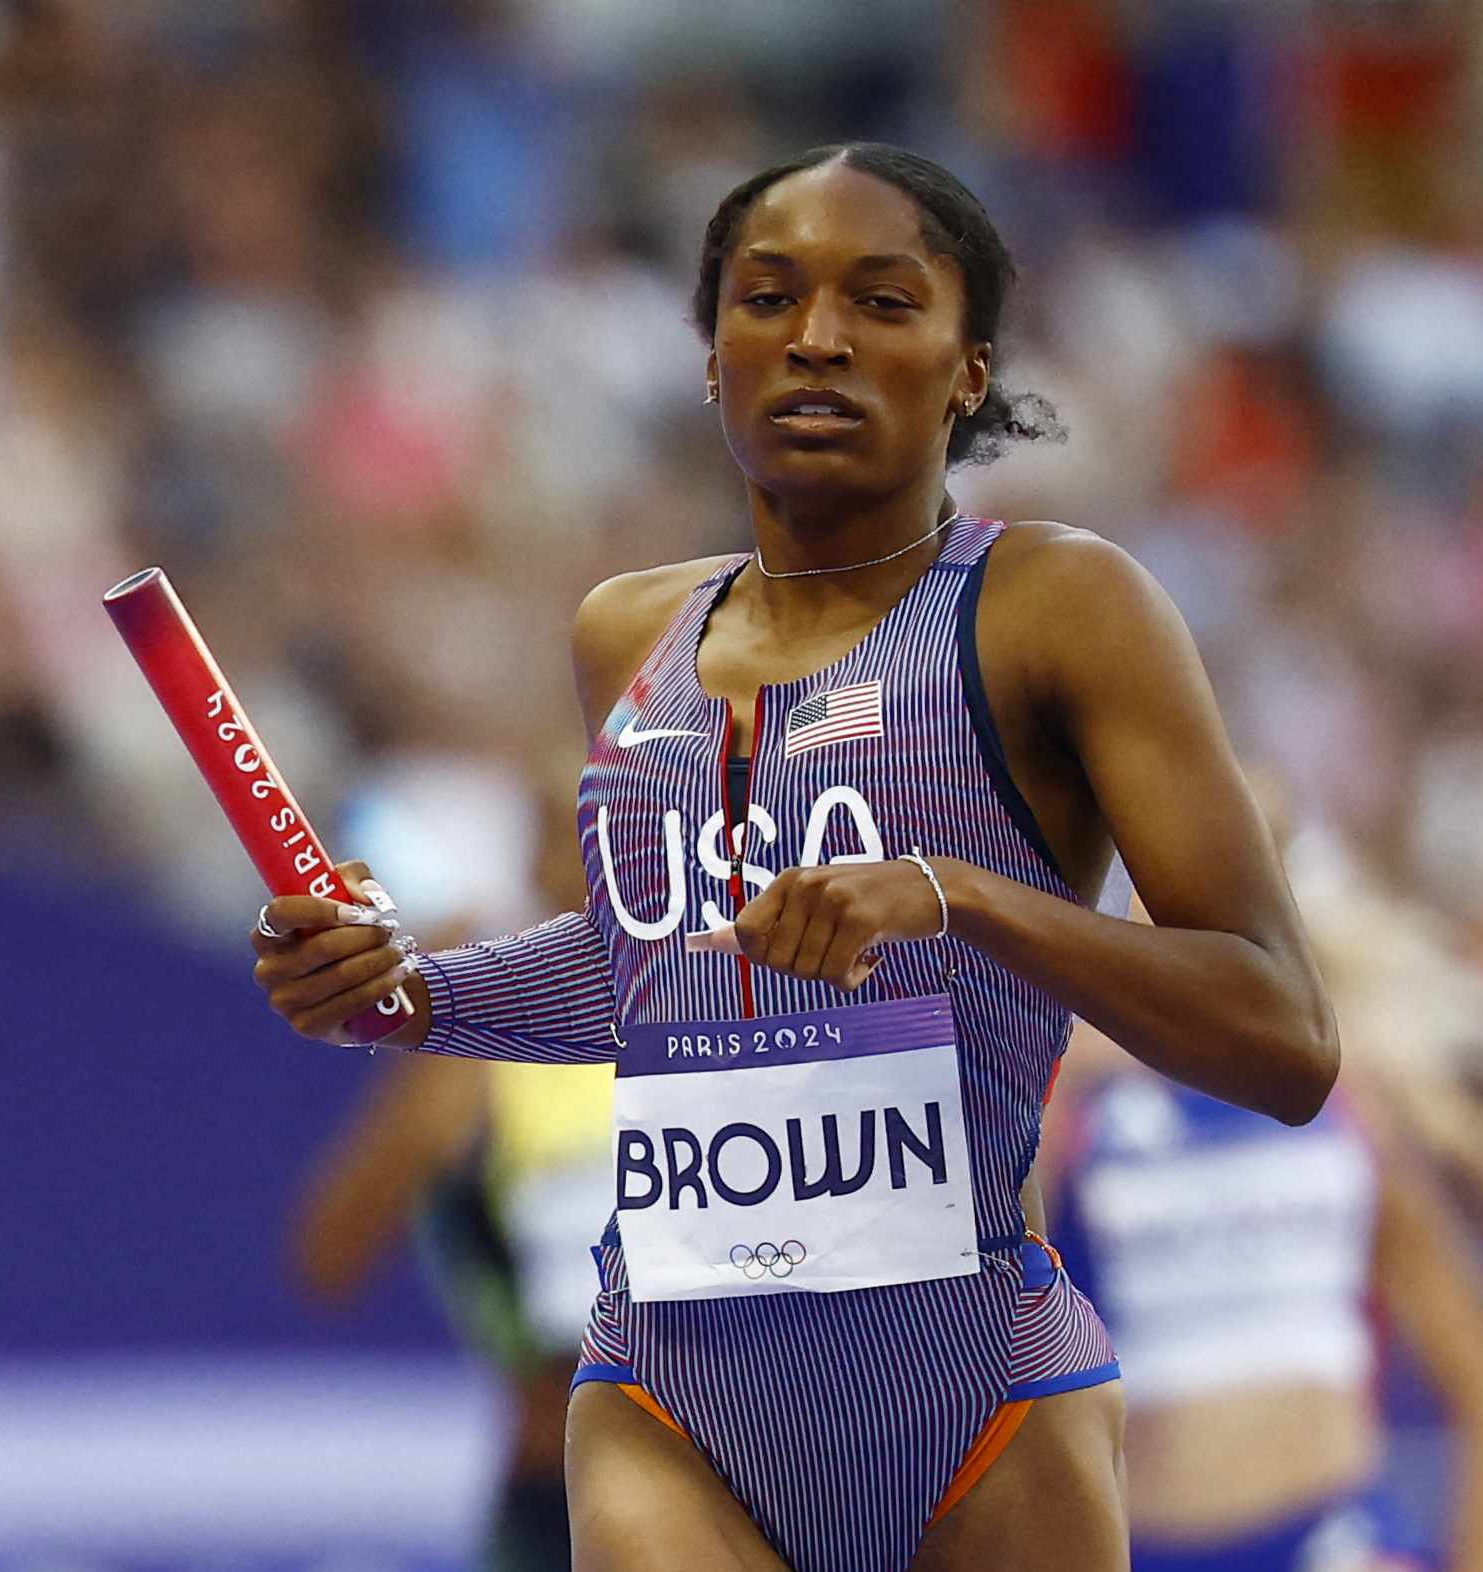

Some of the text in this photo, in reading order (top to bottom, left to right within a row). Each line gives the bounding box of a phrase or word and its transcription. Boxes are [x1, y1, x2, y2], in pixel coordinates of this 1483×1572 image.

[597, 785, 885, 941] USA
[753, 1022, 842, 1053] 2024
[617, 1101, 949, 1211] BROWN
